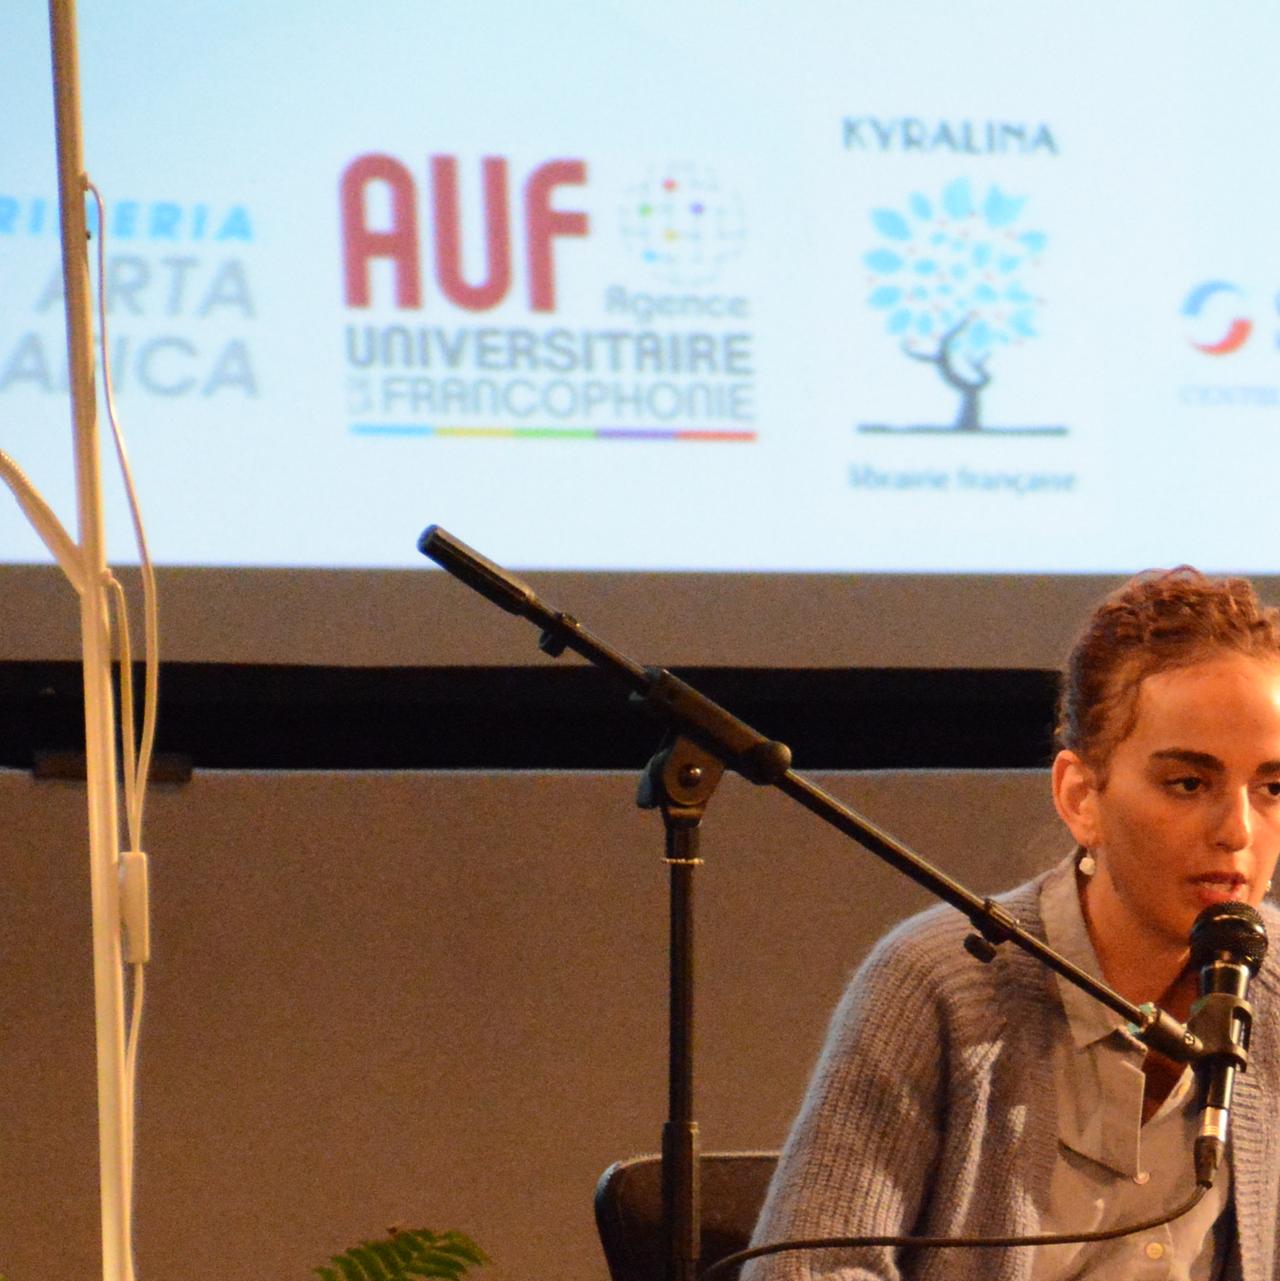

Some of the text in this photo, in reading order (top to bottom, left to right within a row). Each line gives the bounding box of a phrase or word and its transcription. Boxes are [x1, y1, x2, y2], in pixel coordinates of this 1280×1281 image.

[843, 117, 1060, 156] KYRALINA
[341, 153, 591, 315] AUF
[605, 285, 750, 324] Agence
[346, 324, 755, 376] UNIVERSITAIRE
[381, 375, 756, 422] FRANCOPHONIE
